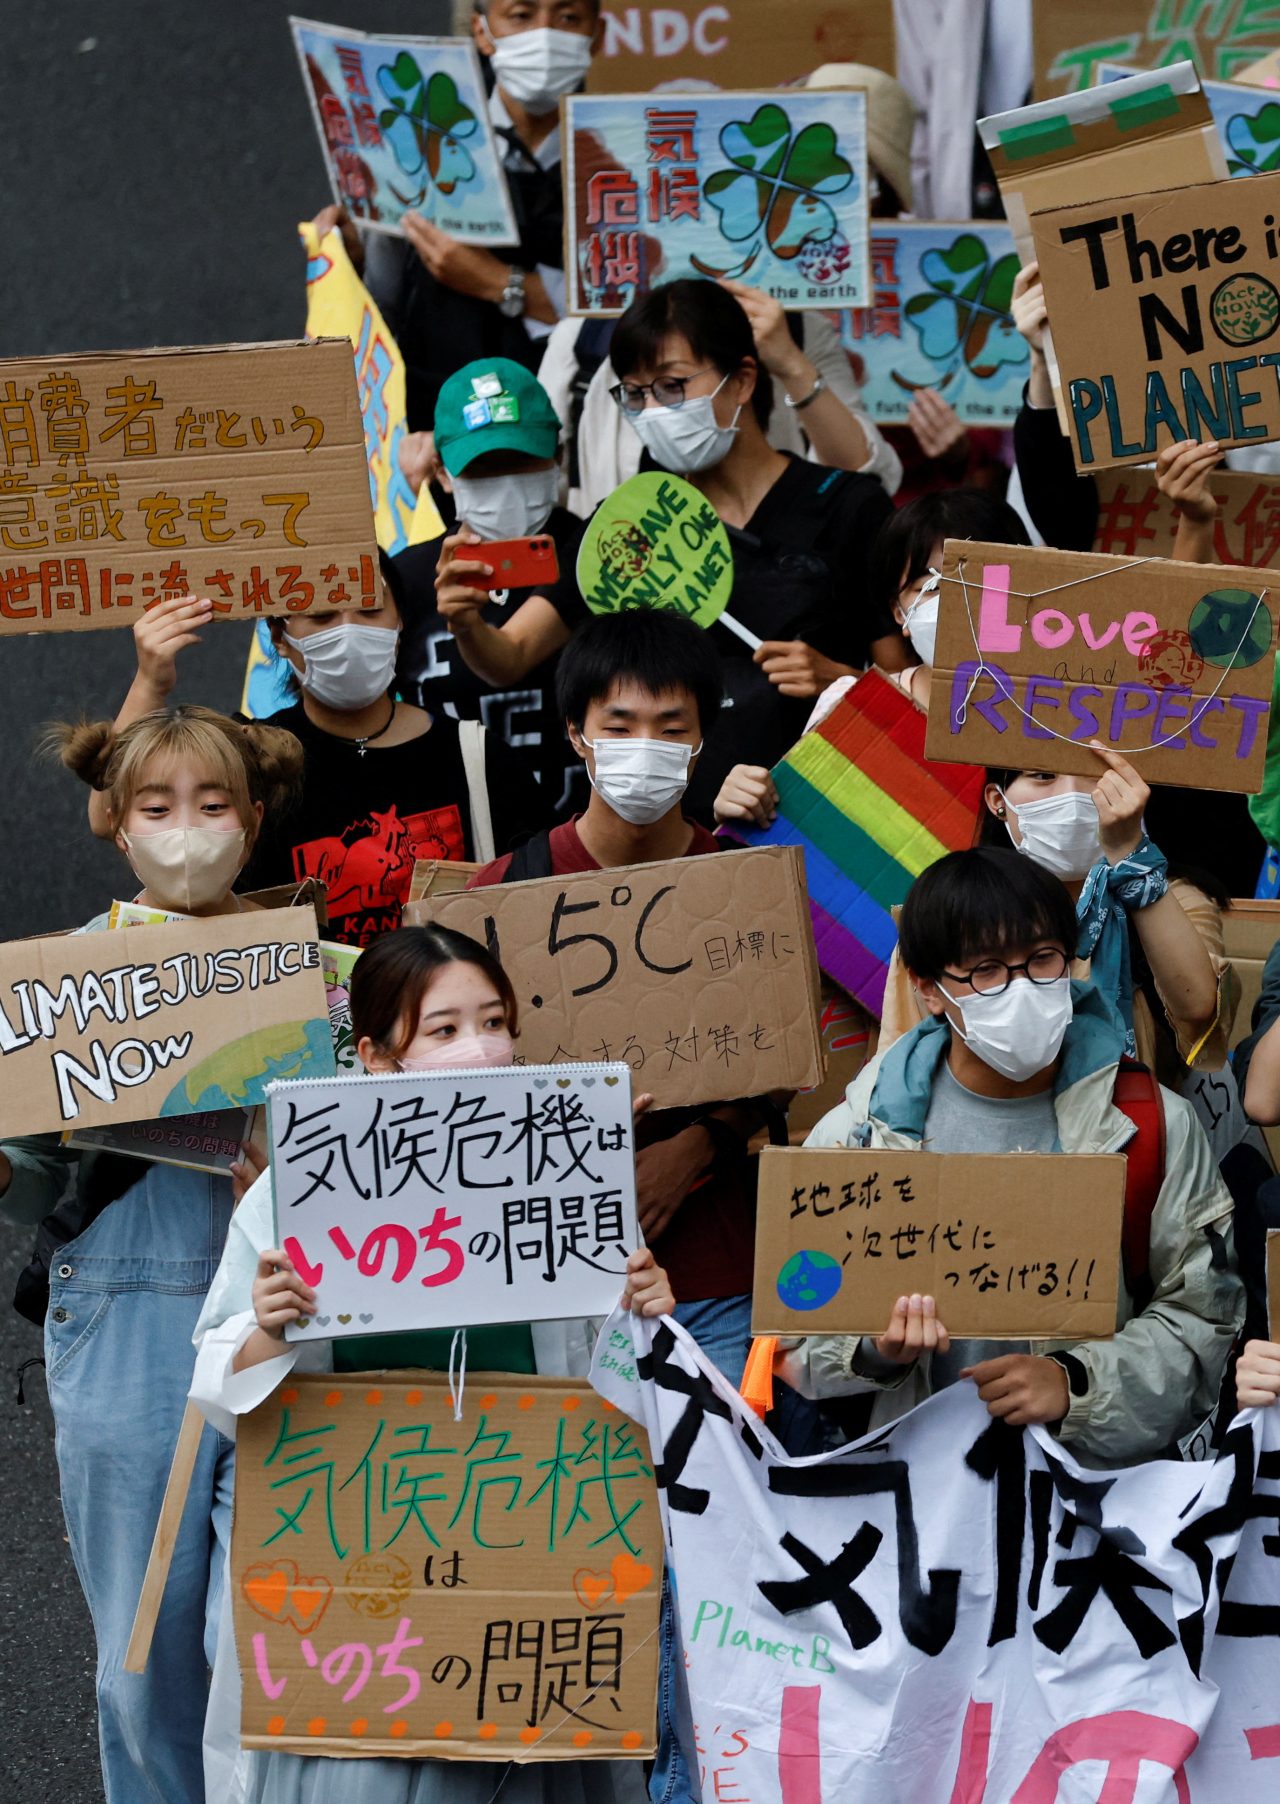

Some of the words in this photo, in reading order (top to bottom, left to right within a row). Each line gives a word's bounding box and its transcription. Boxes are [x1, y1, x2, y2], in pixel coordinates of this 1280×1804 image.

[645, 108, 700, 223] 気候
[586, 169, 640, 288] 危機
[1059, 211, 1247, 291] There
[769, 285, 798, 299] the
[807, 283, 857, 299] earth
[0, 371, 326, 469] 消費者だという
[0, 469, 312, 551] 意識をもって
[679, 502, 720, 551] ONE
[977, 564, 1160, 657] Love
[949, 660, 1271, 760] RESPECT
[159, 940, 321, 1006] JUSTICE
[704, 929, 797, 973] 目標に
[276, 1091, 630, 1207] 気候危機は
[790, 1171, 918, 1220] 地球を
[282, 1189, 631, 1289] いのちの問題
[841, 1219, 997, 1266] 次世代に
[261, 1408, 655, 1560] 気候危機
[423, 1550, 468, 1588] は
[251, 1612, 629, 1732] いのちの問題
[690, 1599, 805, 1668] Planet
